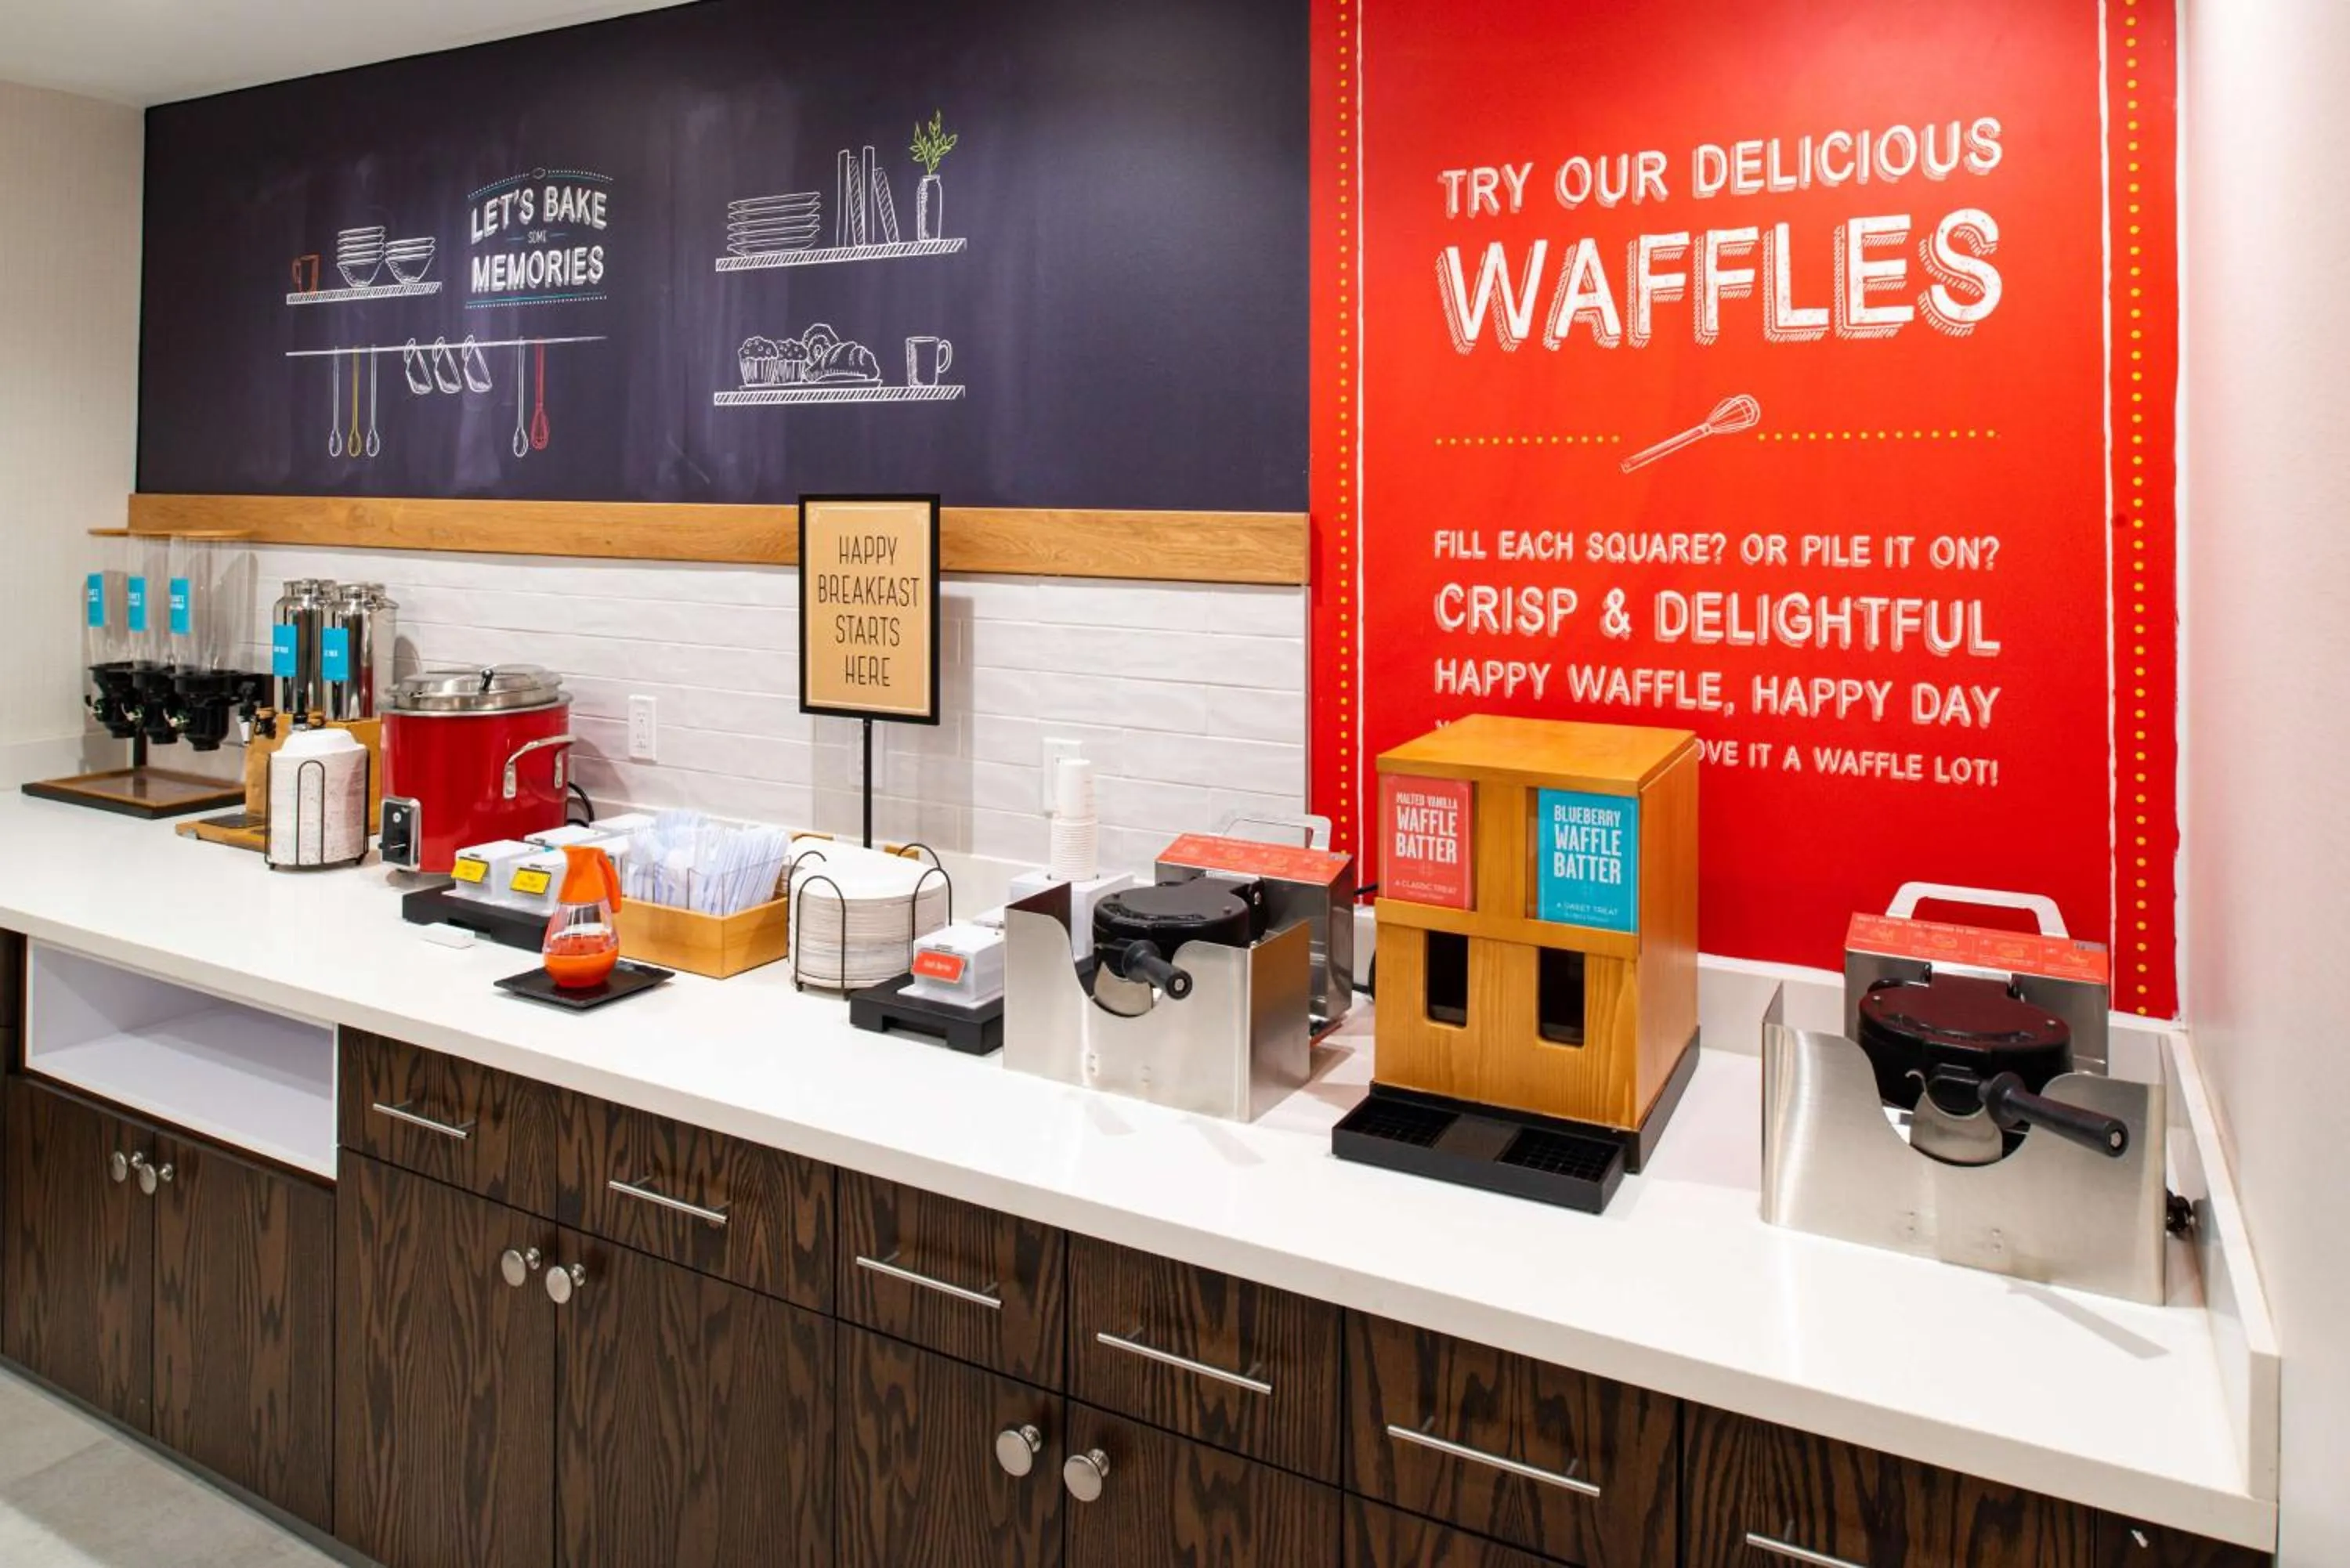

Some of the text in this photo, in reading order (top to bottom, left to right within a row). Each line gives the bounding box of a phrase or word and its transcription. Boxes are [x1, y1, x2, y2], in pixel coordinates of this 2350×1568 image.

[1438, 117, 2003, 219] TRY OUR DELICIOUS
[472, 186, 607, 245] LET'S BAKE
[527, 230, 548, 244] SOME
[472, 245, 605, 294] MEMORIES
[1435, 208, 2003, 355] WAFFLES
[838, 534, 898, 565] HAPPY
[1434, 529, 2000, 571] FILL EACH SQUARE? OR PILE IT ON?
[818, 574, 920, 607] BREAKFAST
[835, 614, 901, 647] STARTS
[1434, 583, 2001, 657] CRISP & DELIGHTFUL
[845, 655, 891, 687] HERE
[1434, 658, 2001, 728] HAPPY WAFFLE, HAPPY DAY
[1748, 742, 1773, 769] IT
[1782, 745, 1802, 772] A
[1813, 746, 1923, 780] WAFFLE
[1934, 756, 1999, 787] LOT!
[1396, 792, 1458, 809] MALTED VANILLA
[1553, 804, 1622, 828] BLUEBERRY
[1397, 804, 1458, 837] WAFFLE
[1395, 832, 1458, 865] BATTER
[1554, 824, 1622, 858] WAFFLE
[1553, 851, 1622, 885] BATTER
